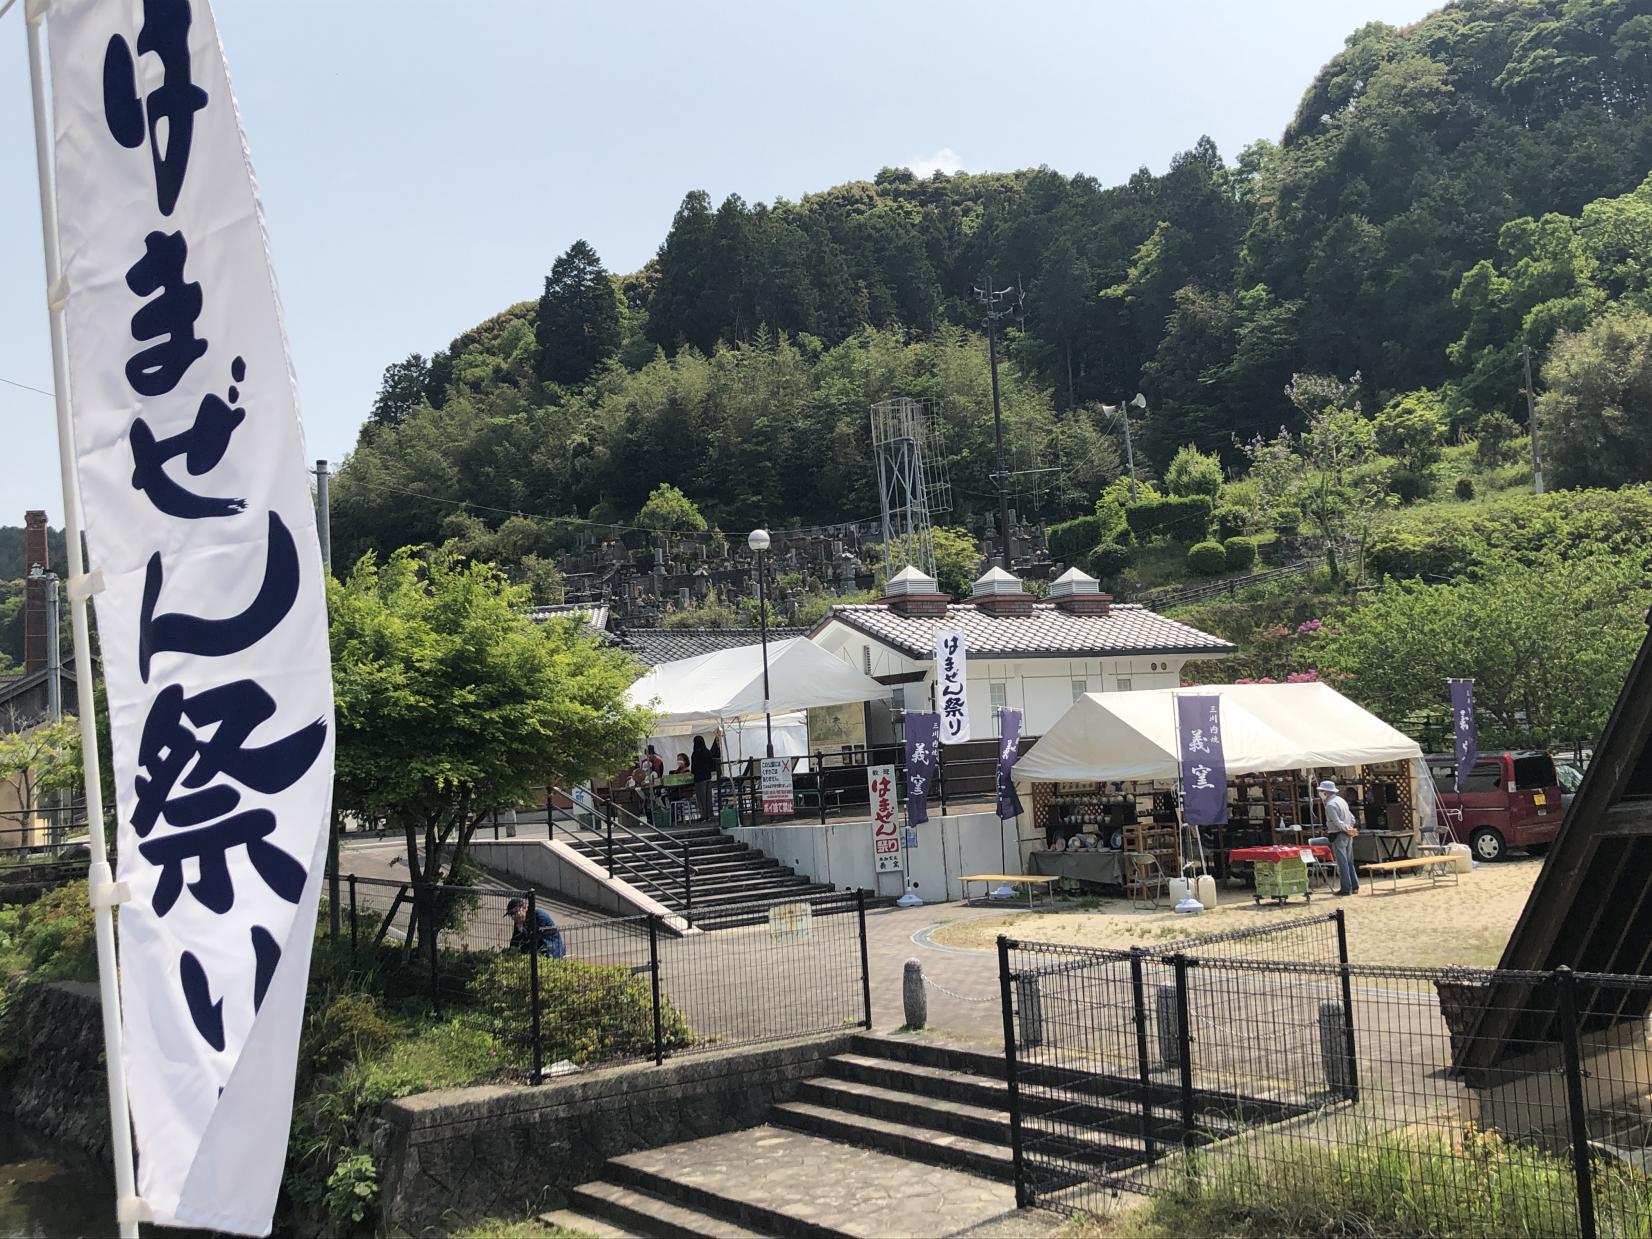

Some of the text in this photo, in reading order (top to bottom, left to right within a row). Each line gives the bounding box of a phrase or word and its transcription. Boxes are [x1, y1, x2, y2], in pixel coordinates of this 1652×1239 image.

[943, 636, 965, 736] はまぜん祭り
[1209, 705, 1220, 744] 三川内焼
[871, 776, 897, 837] はまぜん
[877, 838, 898, 853] 祭り
